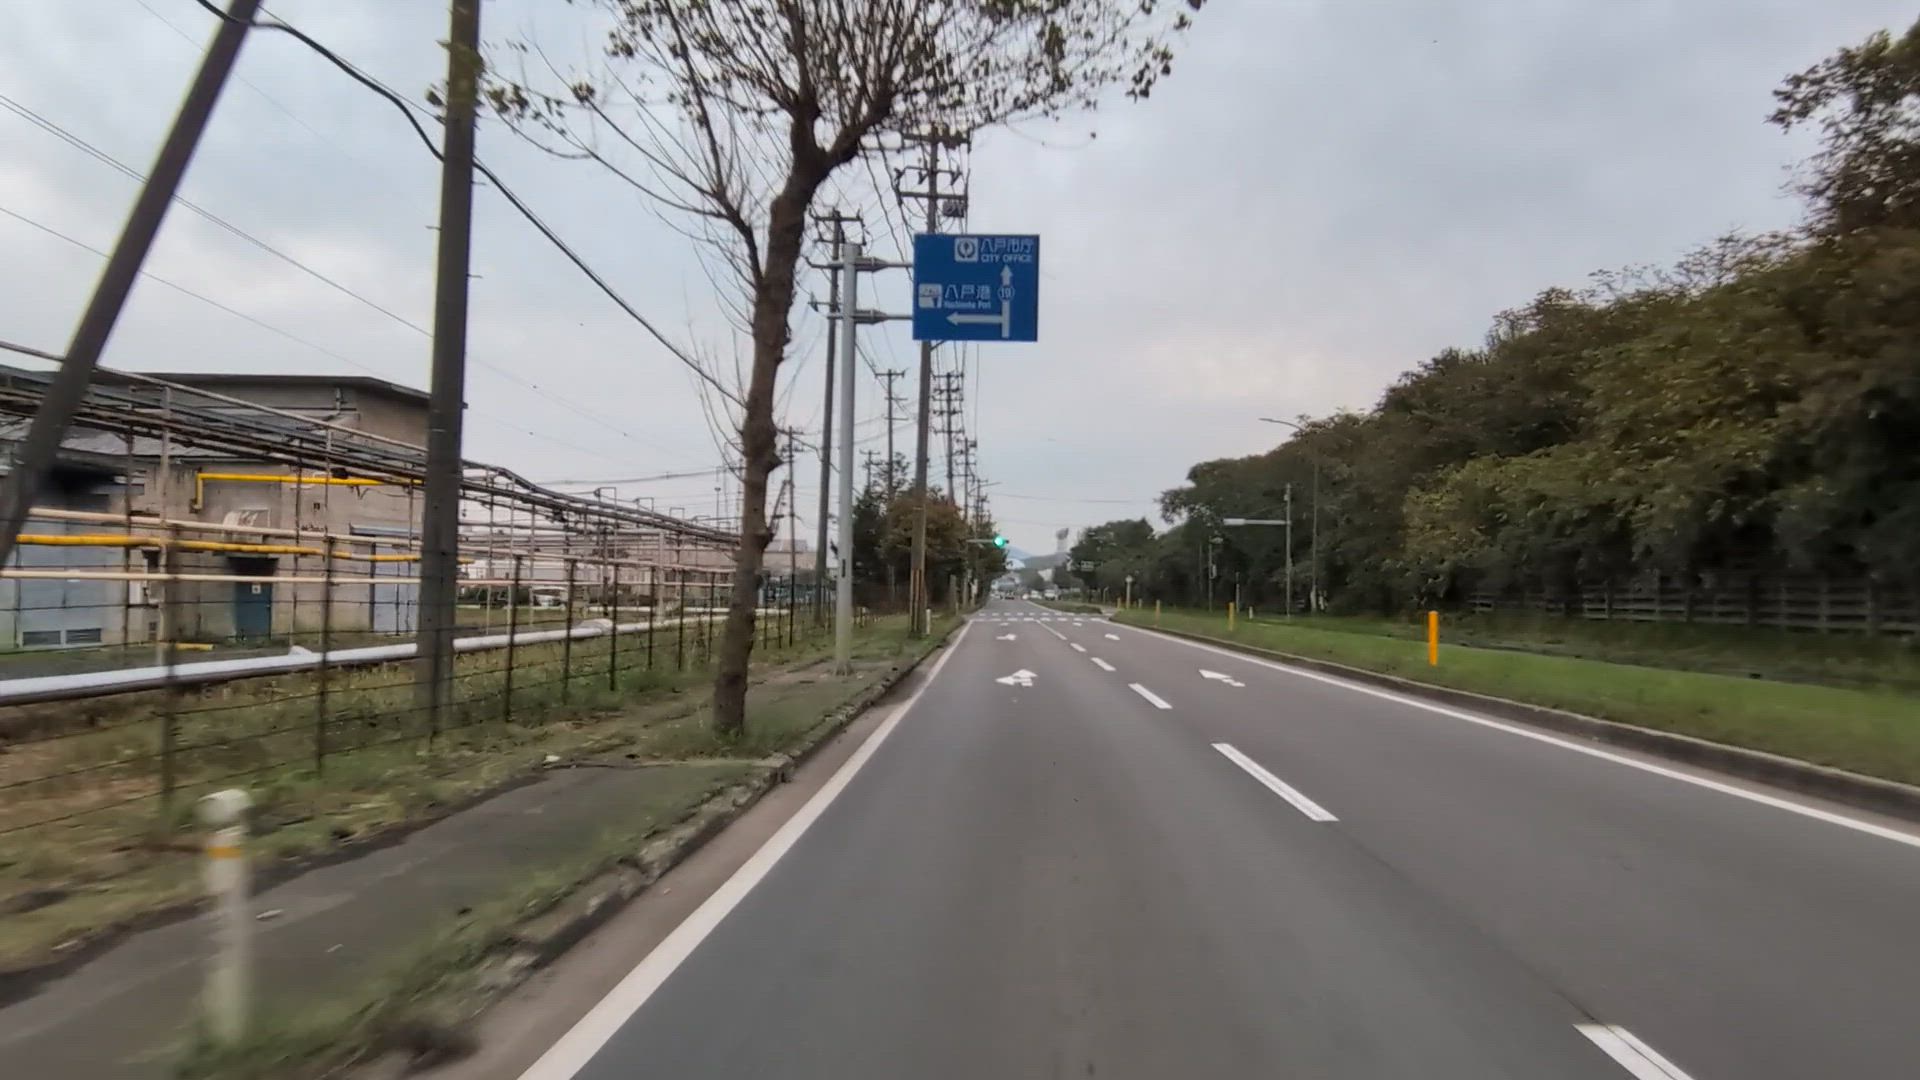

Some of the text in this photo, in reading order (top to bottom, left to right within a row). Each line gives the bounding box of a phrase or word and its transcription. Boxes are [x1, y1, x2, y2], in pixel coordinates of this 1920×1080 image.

[980, 238, 1034, 253] 八戸市庁
[980, 254, 1032, 263] CITY OFFICE
[944, 284, 991, 300] 八戸港
[977, 300, 992, 310] Port
